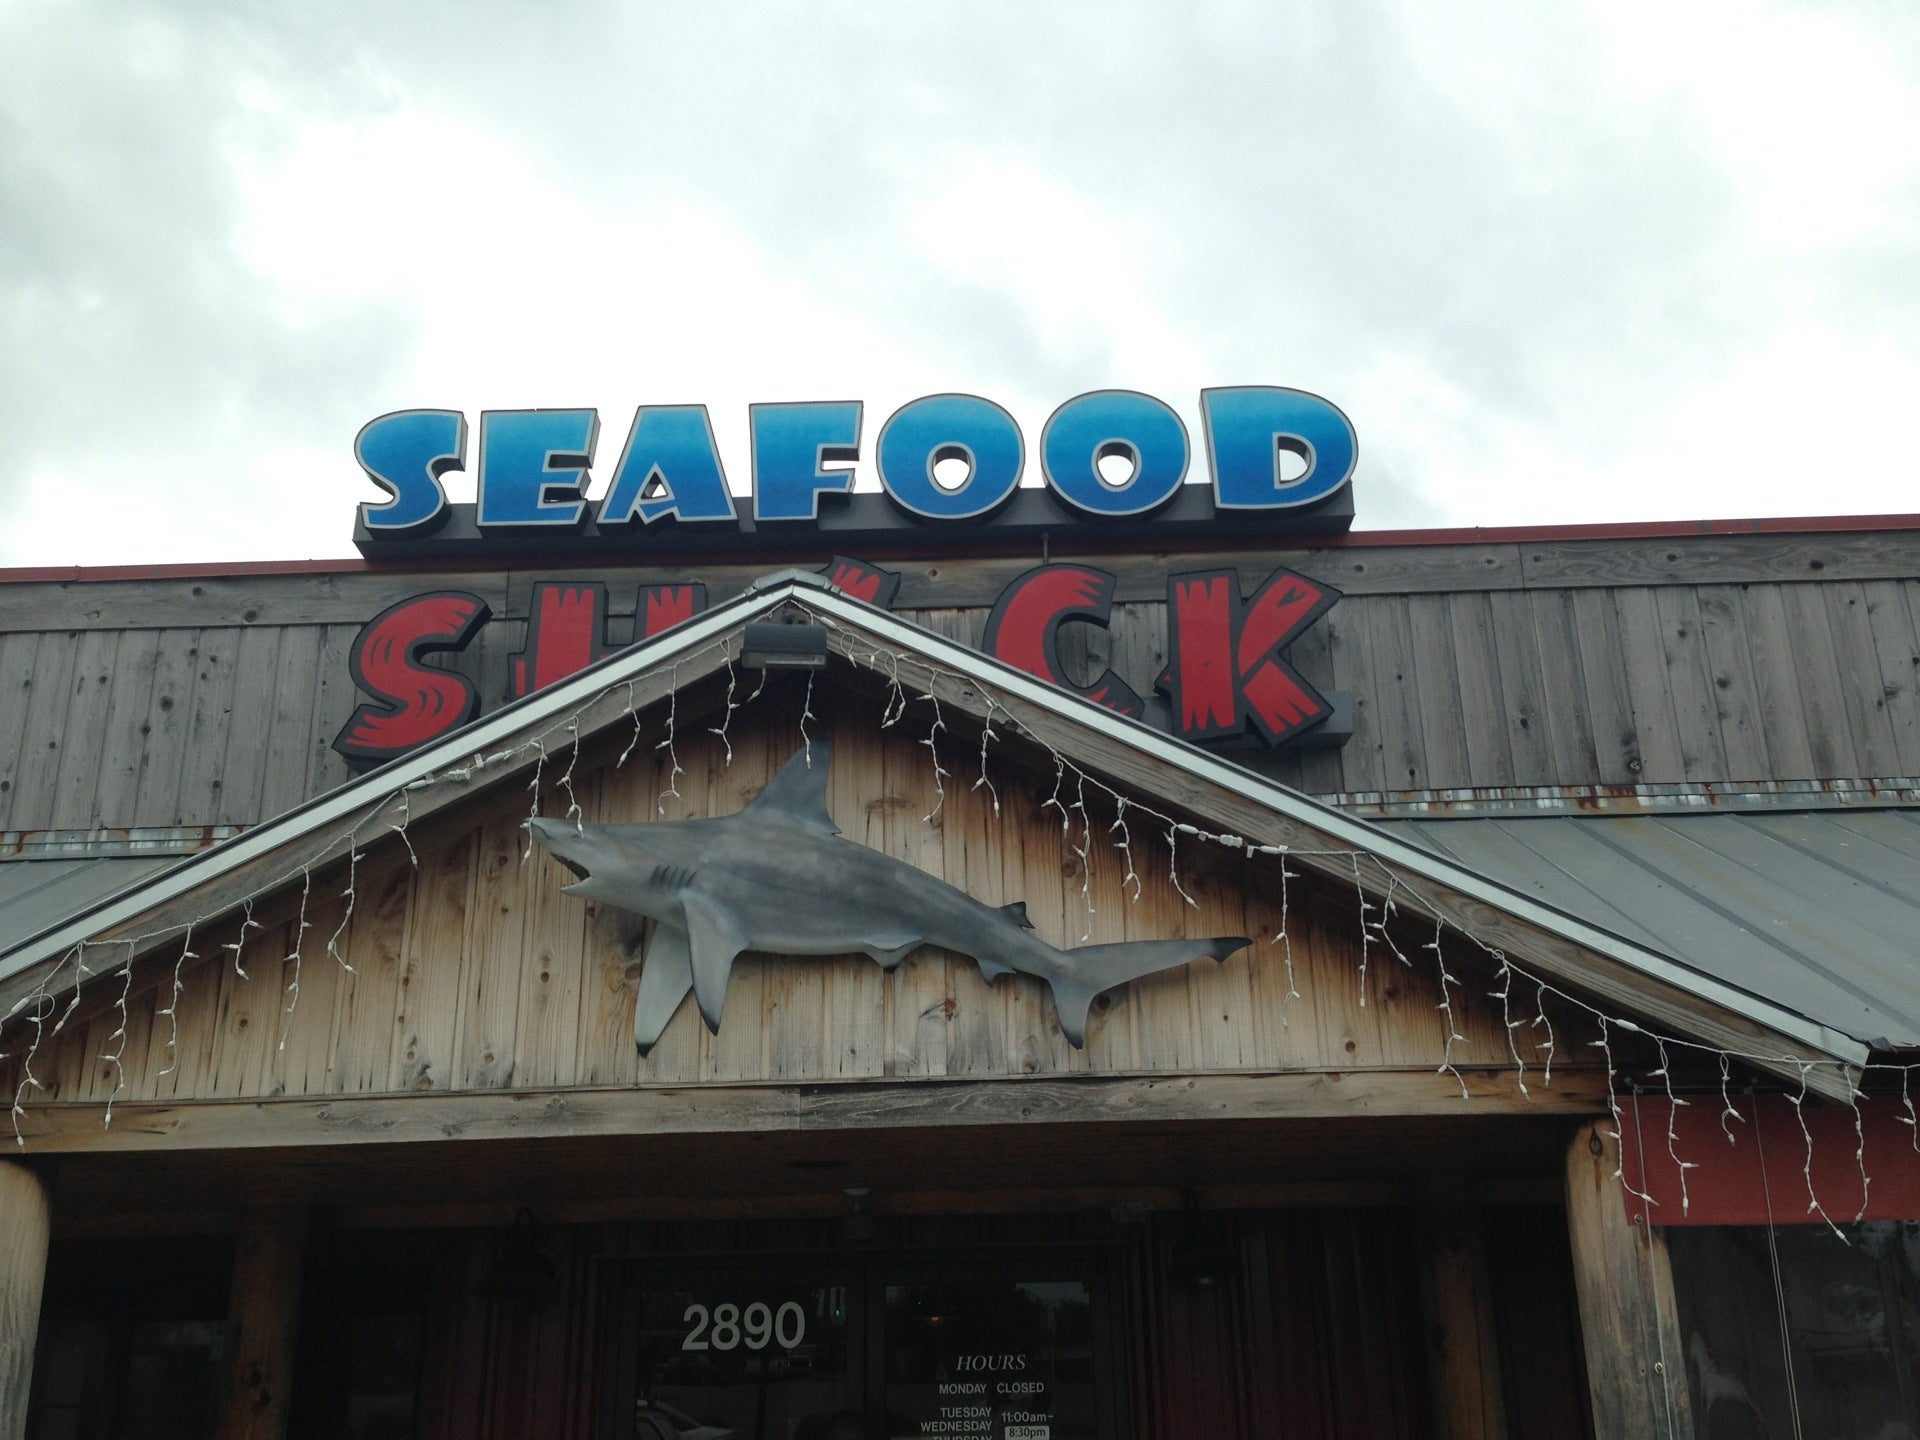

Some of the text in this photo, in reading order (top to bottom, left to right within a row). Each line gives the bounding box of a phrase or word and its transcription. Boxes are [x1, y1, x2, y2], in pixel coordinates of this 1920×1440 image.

[354, 387, 1359, 532] SEAFOOD
[334, 558, 1343, 758] SCK
[681, 1301, 805, 1351] 2890
[956, 1354, 1027, 1371] HOURS
[938, 1382, 1045, 1395] MONDAY CLOSED
[940, 1407, 992, 1418] TUESDAY
[920, 1421, 992, 1432] WEDNESDAY
[1008, 1427, 1047, 1438] 8:30pm
